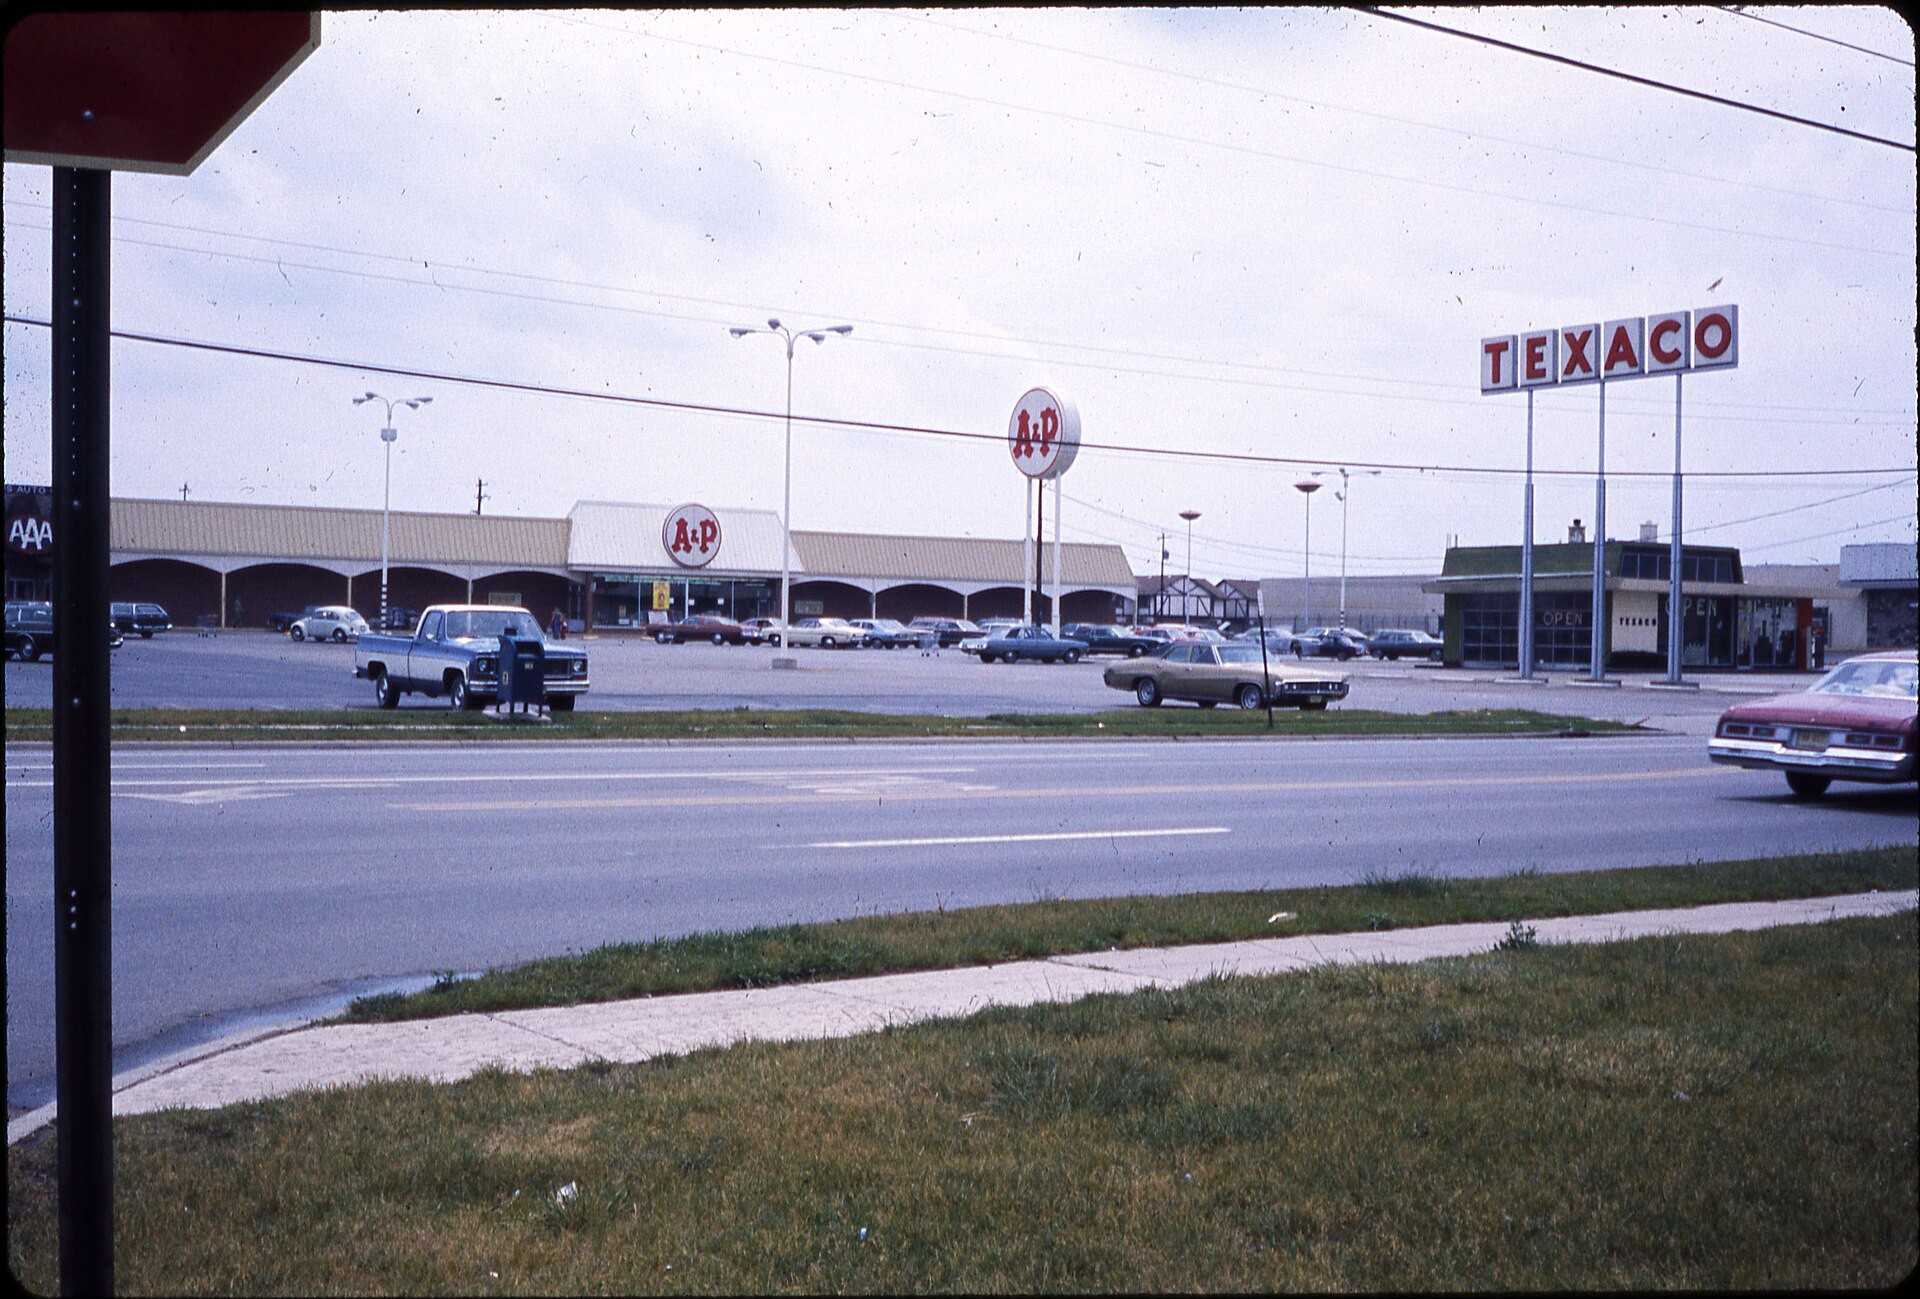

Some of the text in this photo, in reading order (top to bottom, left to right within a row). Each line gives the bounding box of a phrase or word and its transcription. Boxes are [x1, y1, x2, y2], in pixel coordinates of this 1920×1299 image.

[1484, 313, 1732, 384] TEXACO
[1013, 407, 1058, 459] A&P
[9, 518, 53, 550] AAA
[671, 517, 717, 553] A&P
[1543, 611, 1583, 626] OPEN
[1619, 617, 1656, 626] TEXACO
